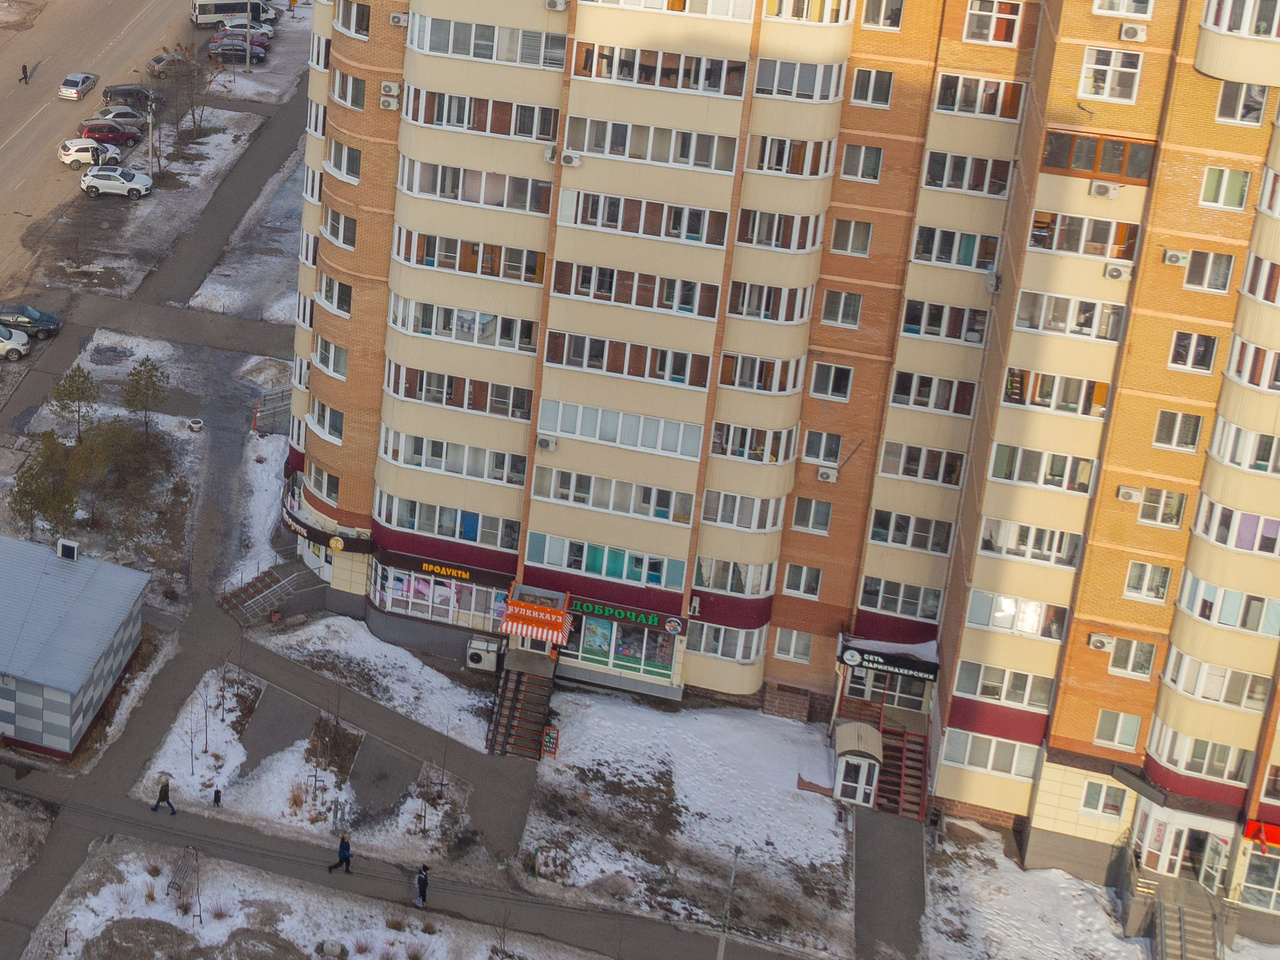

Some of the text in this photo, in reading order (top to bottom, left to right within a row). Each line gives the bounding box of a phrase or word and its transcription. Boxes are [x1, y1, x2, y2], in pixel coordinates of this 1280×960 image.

[422, 563, 470, 579] ПРОДУКТЫ
[508, 605, 563, 623] БУЛКИХАУЗ
[570, 600, 660, 626] ДОБРОЧАЙ
[863, 653, 885, 663] СЕТЬ
[862, 661, 935, 680] ПАРИКМАХЕРСКИХ
